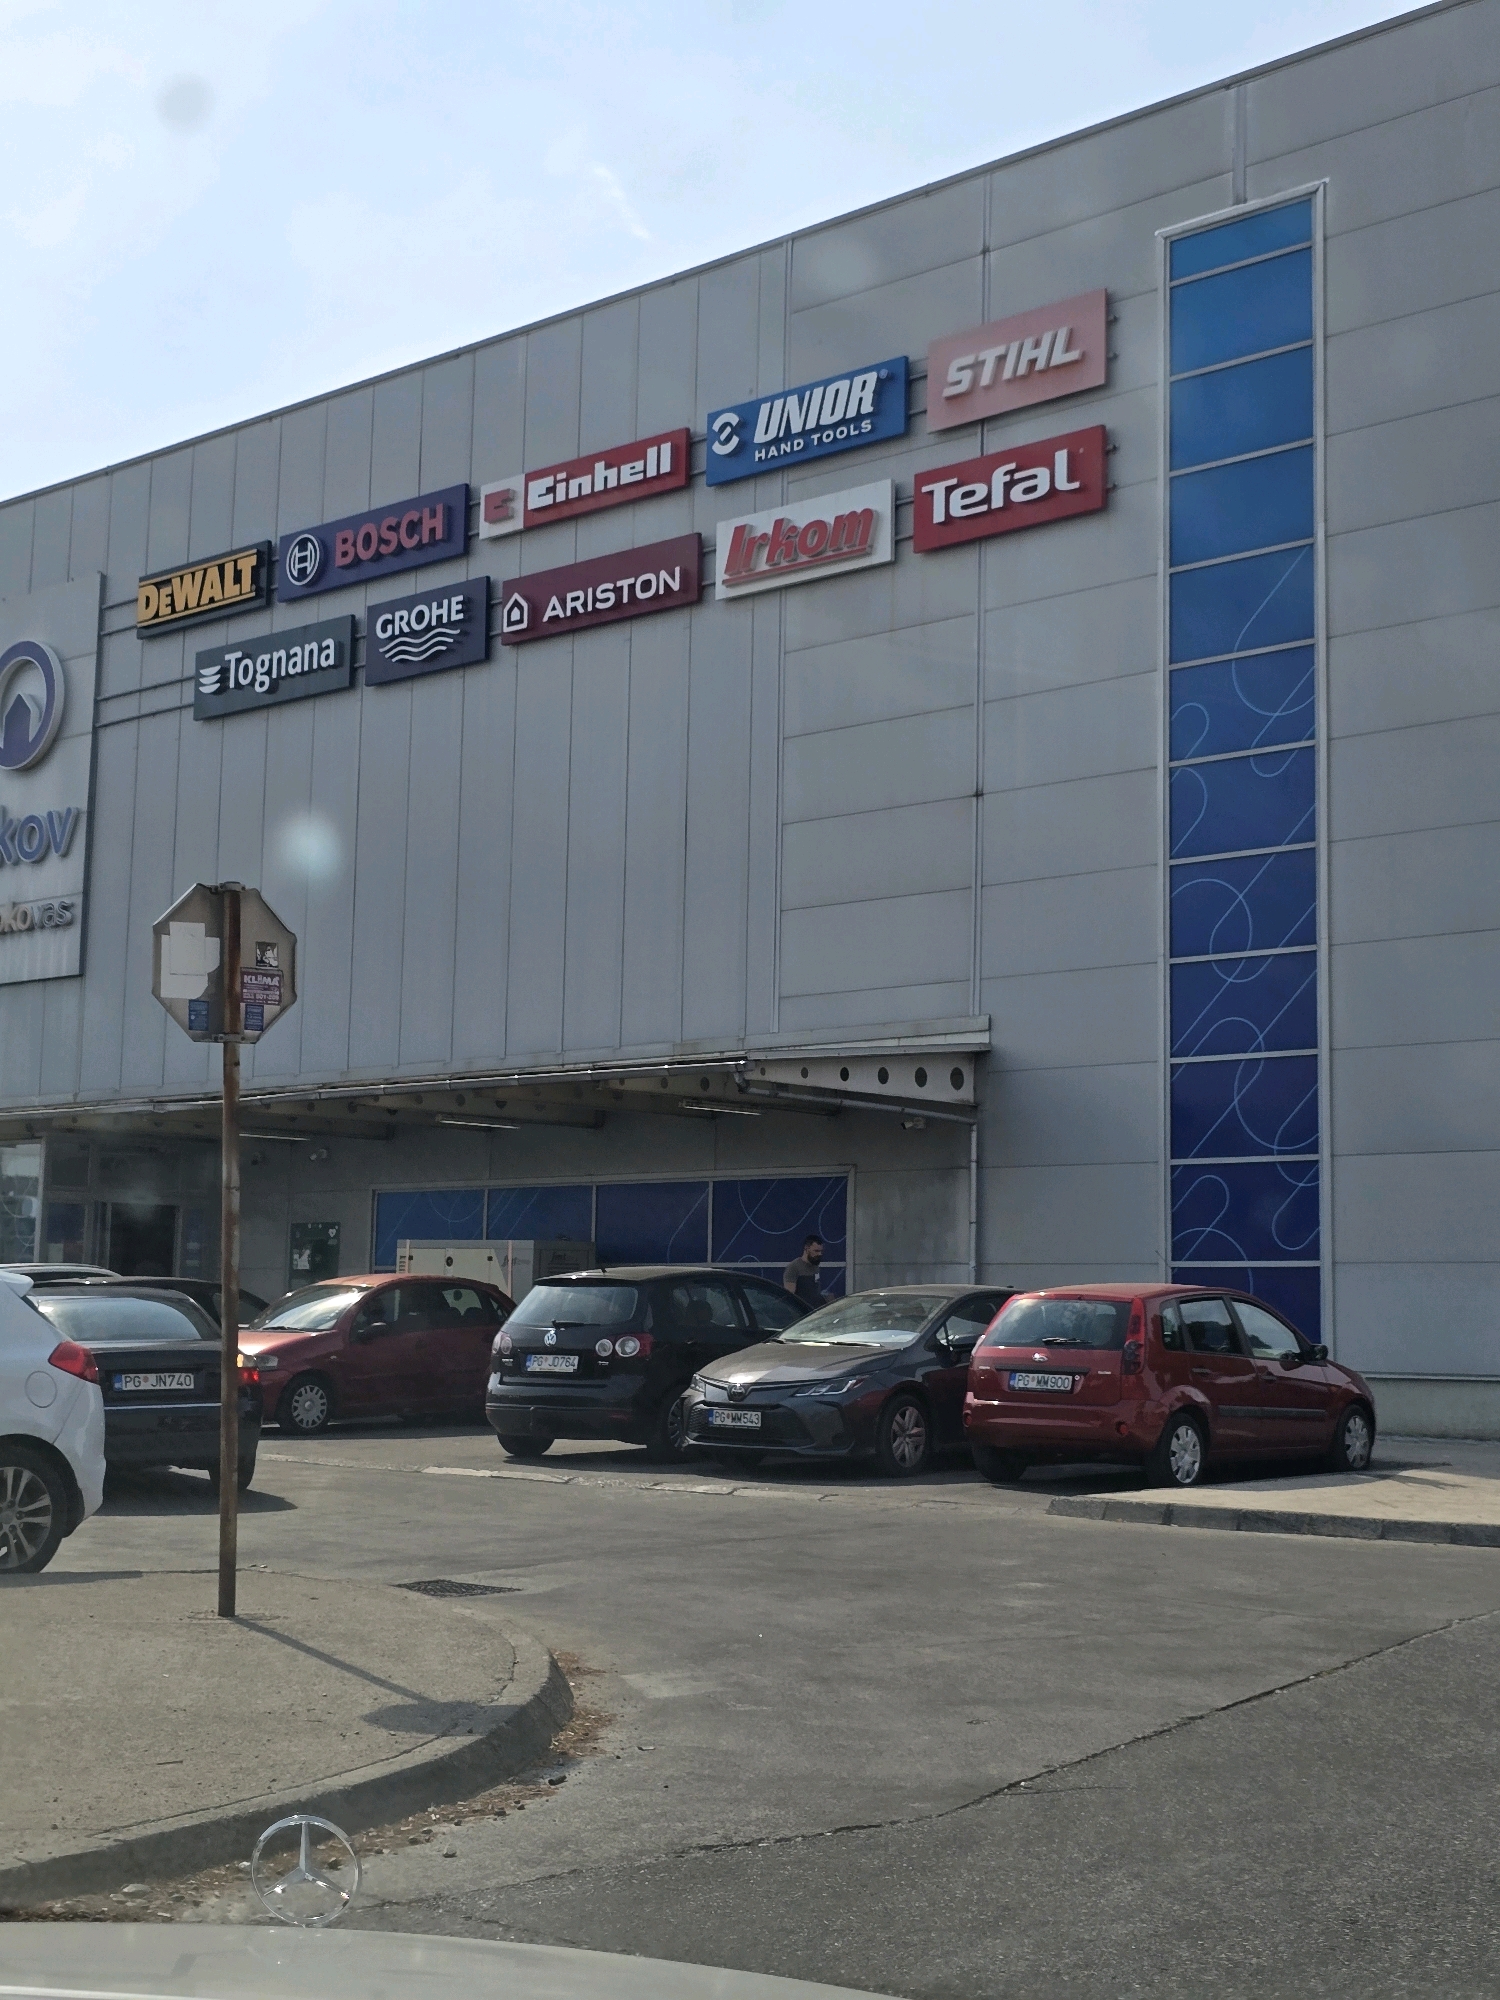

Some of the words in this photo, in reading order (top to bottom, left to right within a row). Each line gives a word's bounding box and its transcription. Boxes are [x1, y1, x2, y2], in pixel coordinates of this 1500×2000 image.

[942, 326, 1081, 398] STIHL
[753, 371, 878, 443] UNIOR
[754, 438, 805, 462] HAND
[811, 419, 873, 446] TOOLS
[527, 441, 672, 511] Einhell
[921, 448, 1081, 525] Tefal
[335, 503, 444, 567] BOSCH
[723, 507, 877, 578] Irkom
[375, 594, 465, 640] GROHE
[542, 565, 681, 623] ARISTON
[224, 637, 336, 694] Tognana
[124, 1375, 142, 1388] PG
[150, 1374, 192, 1388] JN740
[532, 1355, 544, 1367] PG
[1017, 1374, 1030, 1387] PG
[714, 1411, 726, 1423] PG
